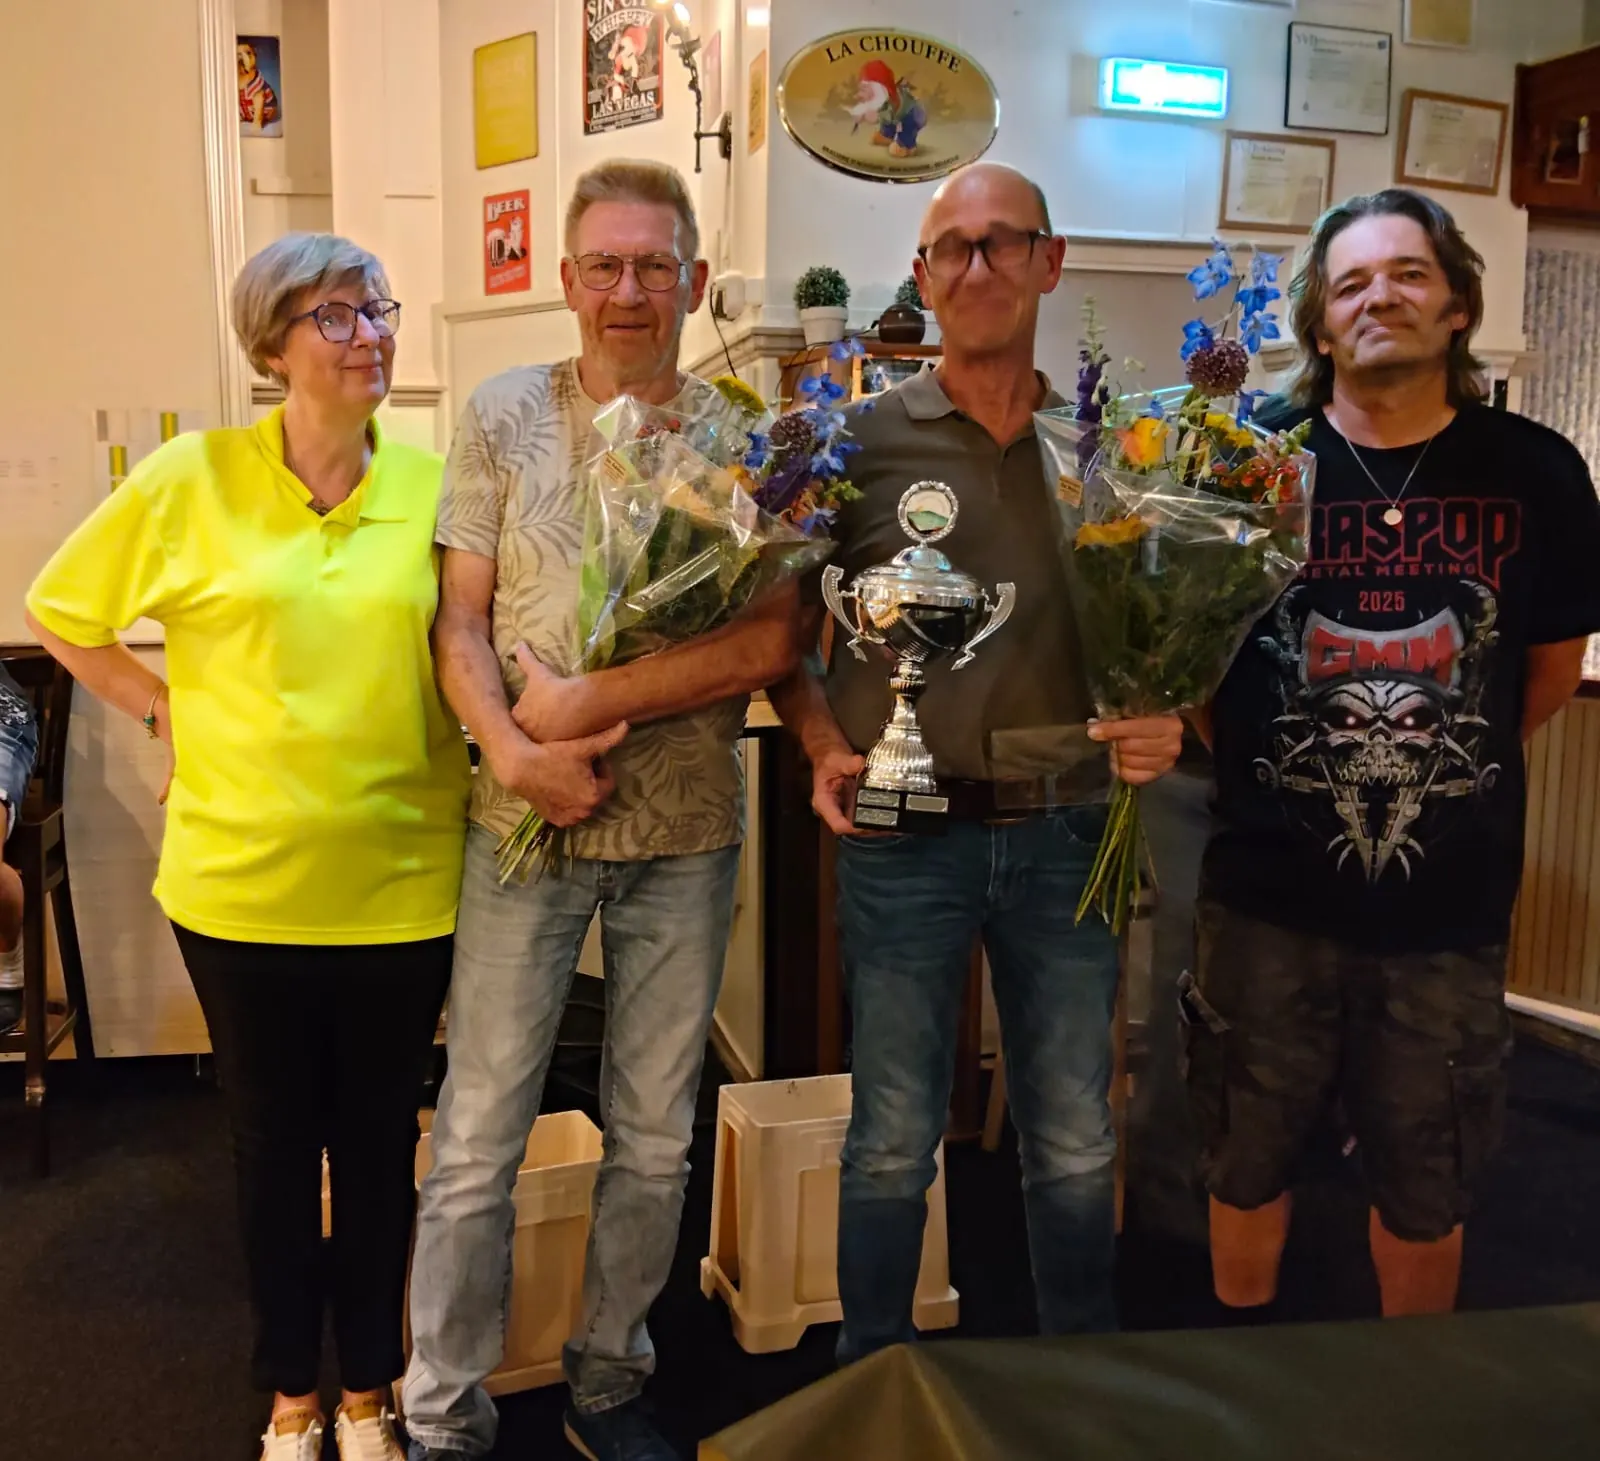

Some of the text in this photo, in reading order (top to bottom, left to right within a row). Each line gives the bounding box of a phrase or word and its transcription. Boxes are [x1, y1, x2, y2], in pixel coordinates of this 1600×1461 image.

[826, 35, 961, 74] LA CHOUFFE
[592, 99, 613, 119] LAS
[613, 91, 655, 113] VEGAS
[487, 198, 526, 222] BEER
[1375, 562, 1477, 577] MEETING
[1359, 591, 1405, 612] 2025
[1307, 625, 1456, 688] GMM
